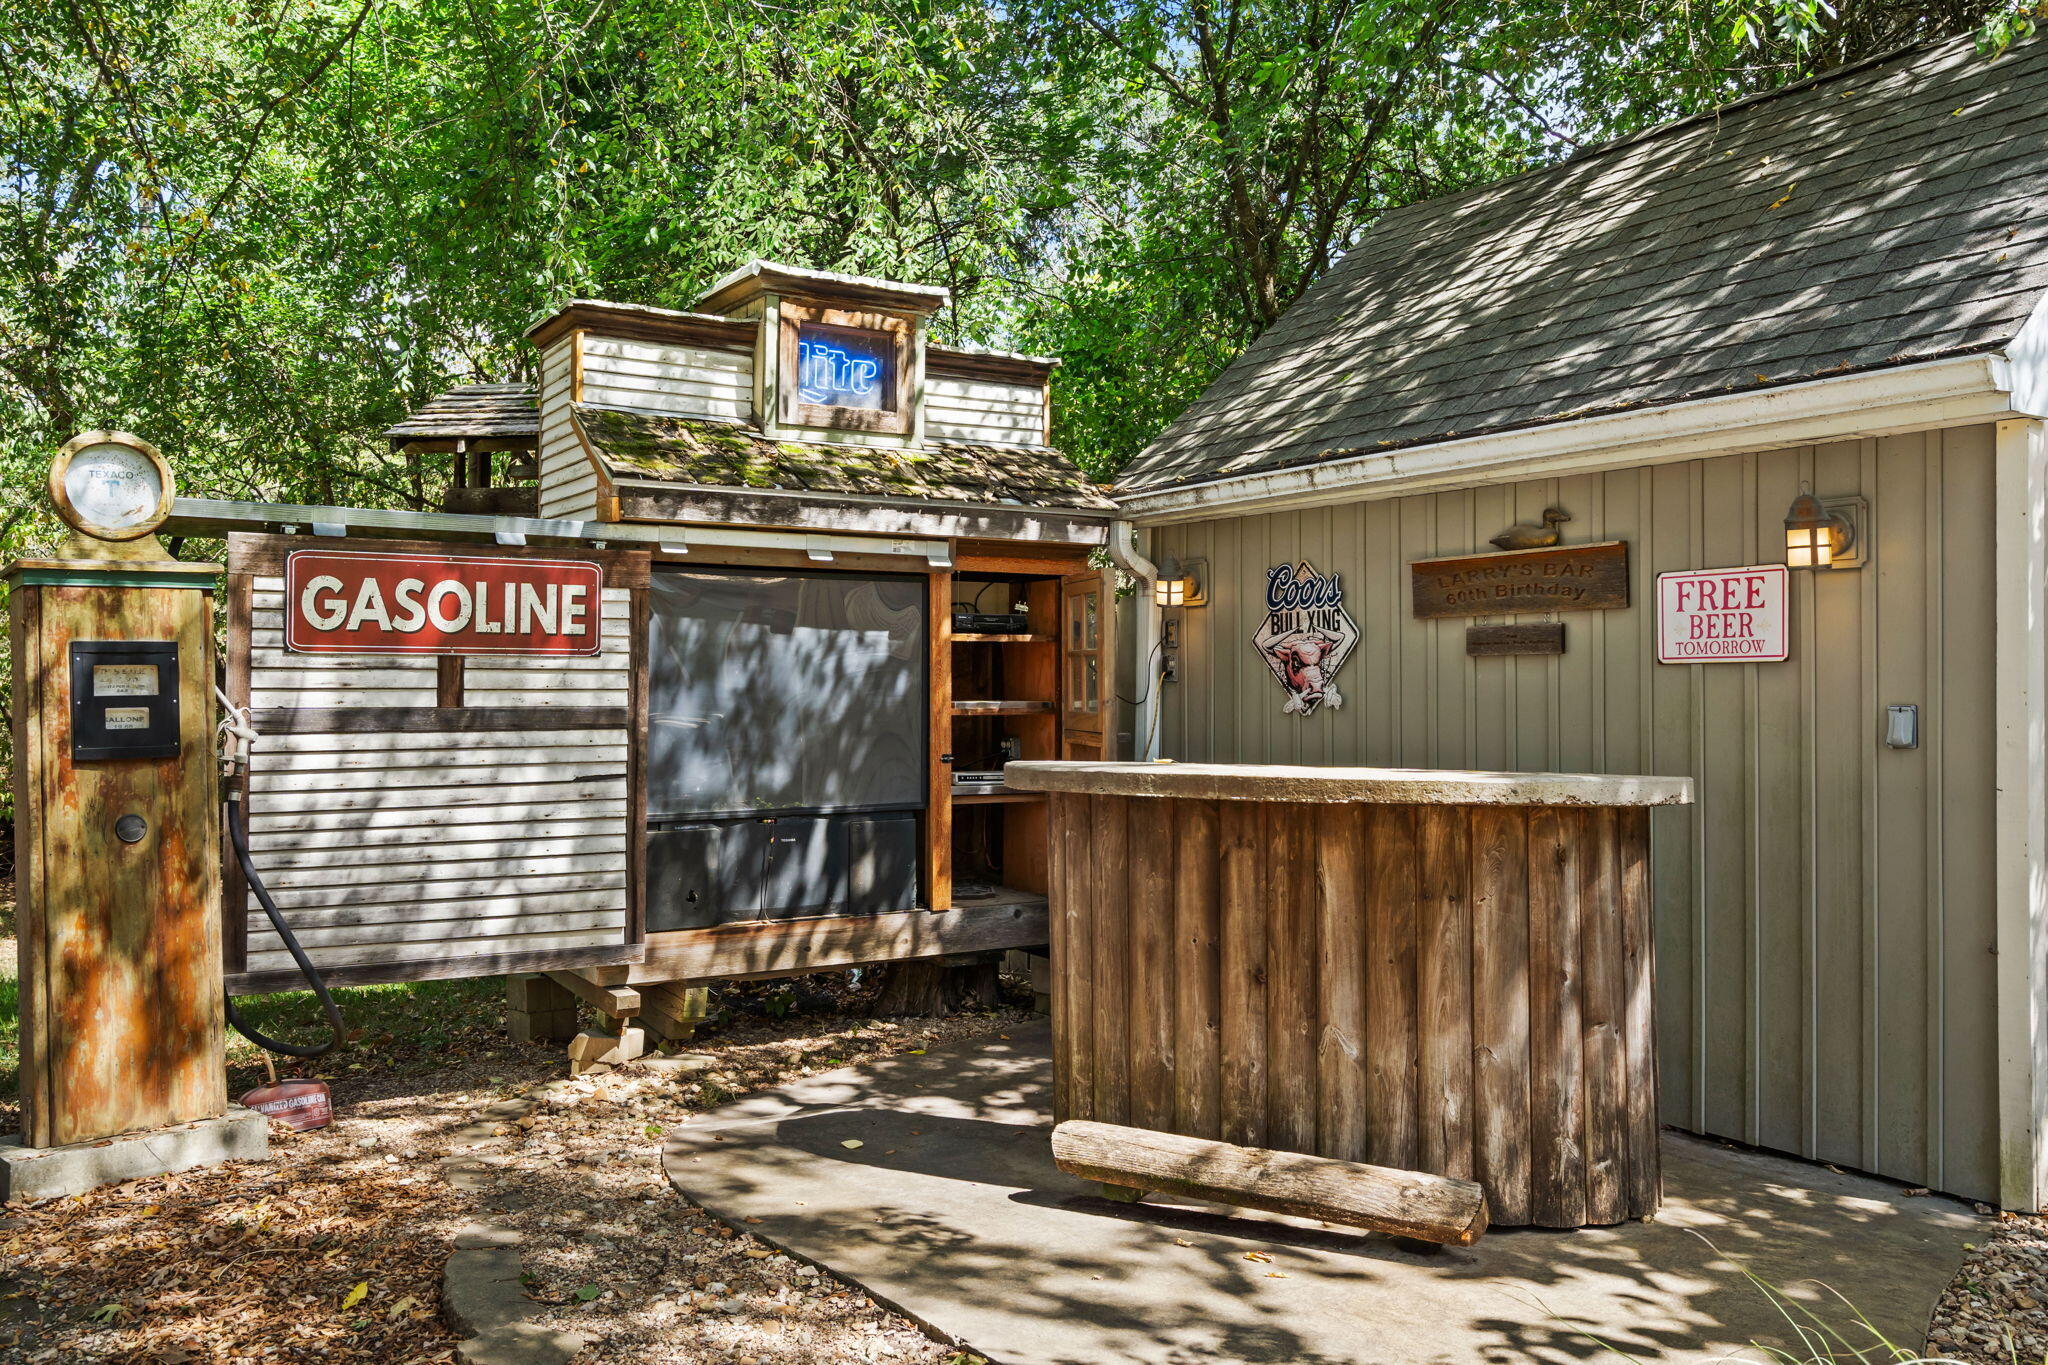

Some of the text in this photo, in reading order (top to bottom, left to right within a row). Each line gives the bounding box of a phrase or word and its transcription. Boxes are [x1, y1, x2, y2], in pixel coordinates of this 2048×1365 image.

[89, 469, 134, 480] TEXACO
[1437, 562, 1594, 588] LARRY'S BAR
[1266, 564, 1342, 613] Coors
[1446, 582, 1586, 606] 60th Birthday
[1675, 576, 1766, 612] FREE
[301, 575, 587, 635] GASOLINE
[1270, 608, 1341, 636] BULL XING
[1689, 612, 1754, 639] BEER
[1675, 639, 1766, 655] TOMORROW
[288, 1095, 317, 1109] GASOLINE
